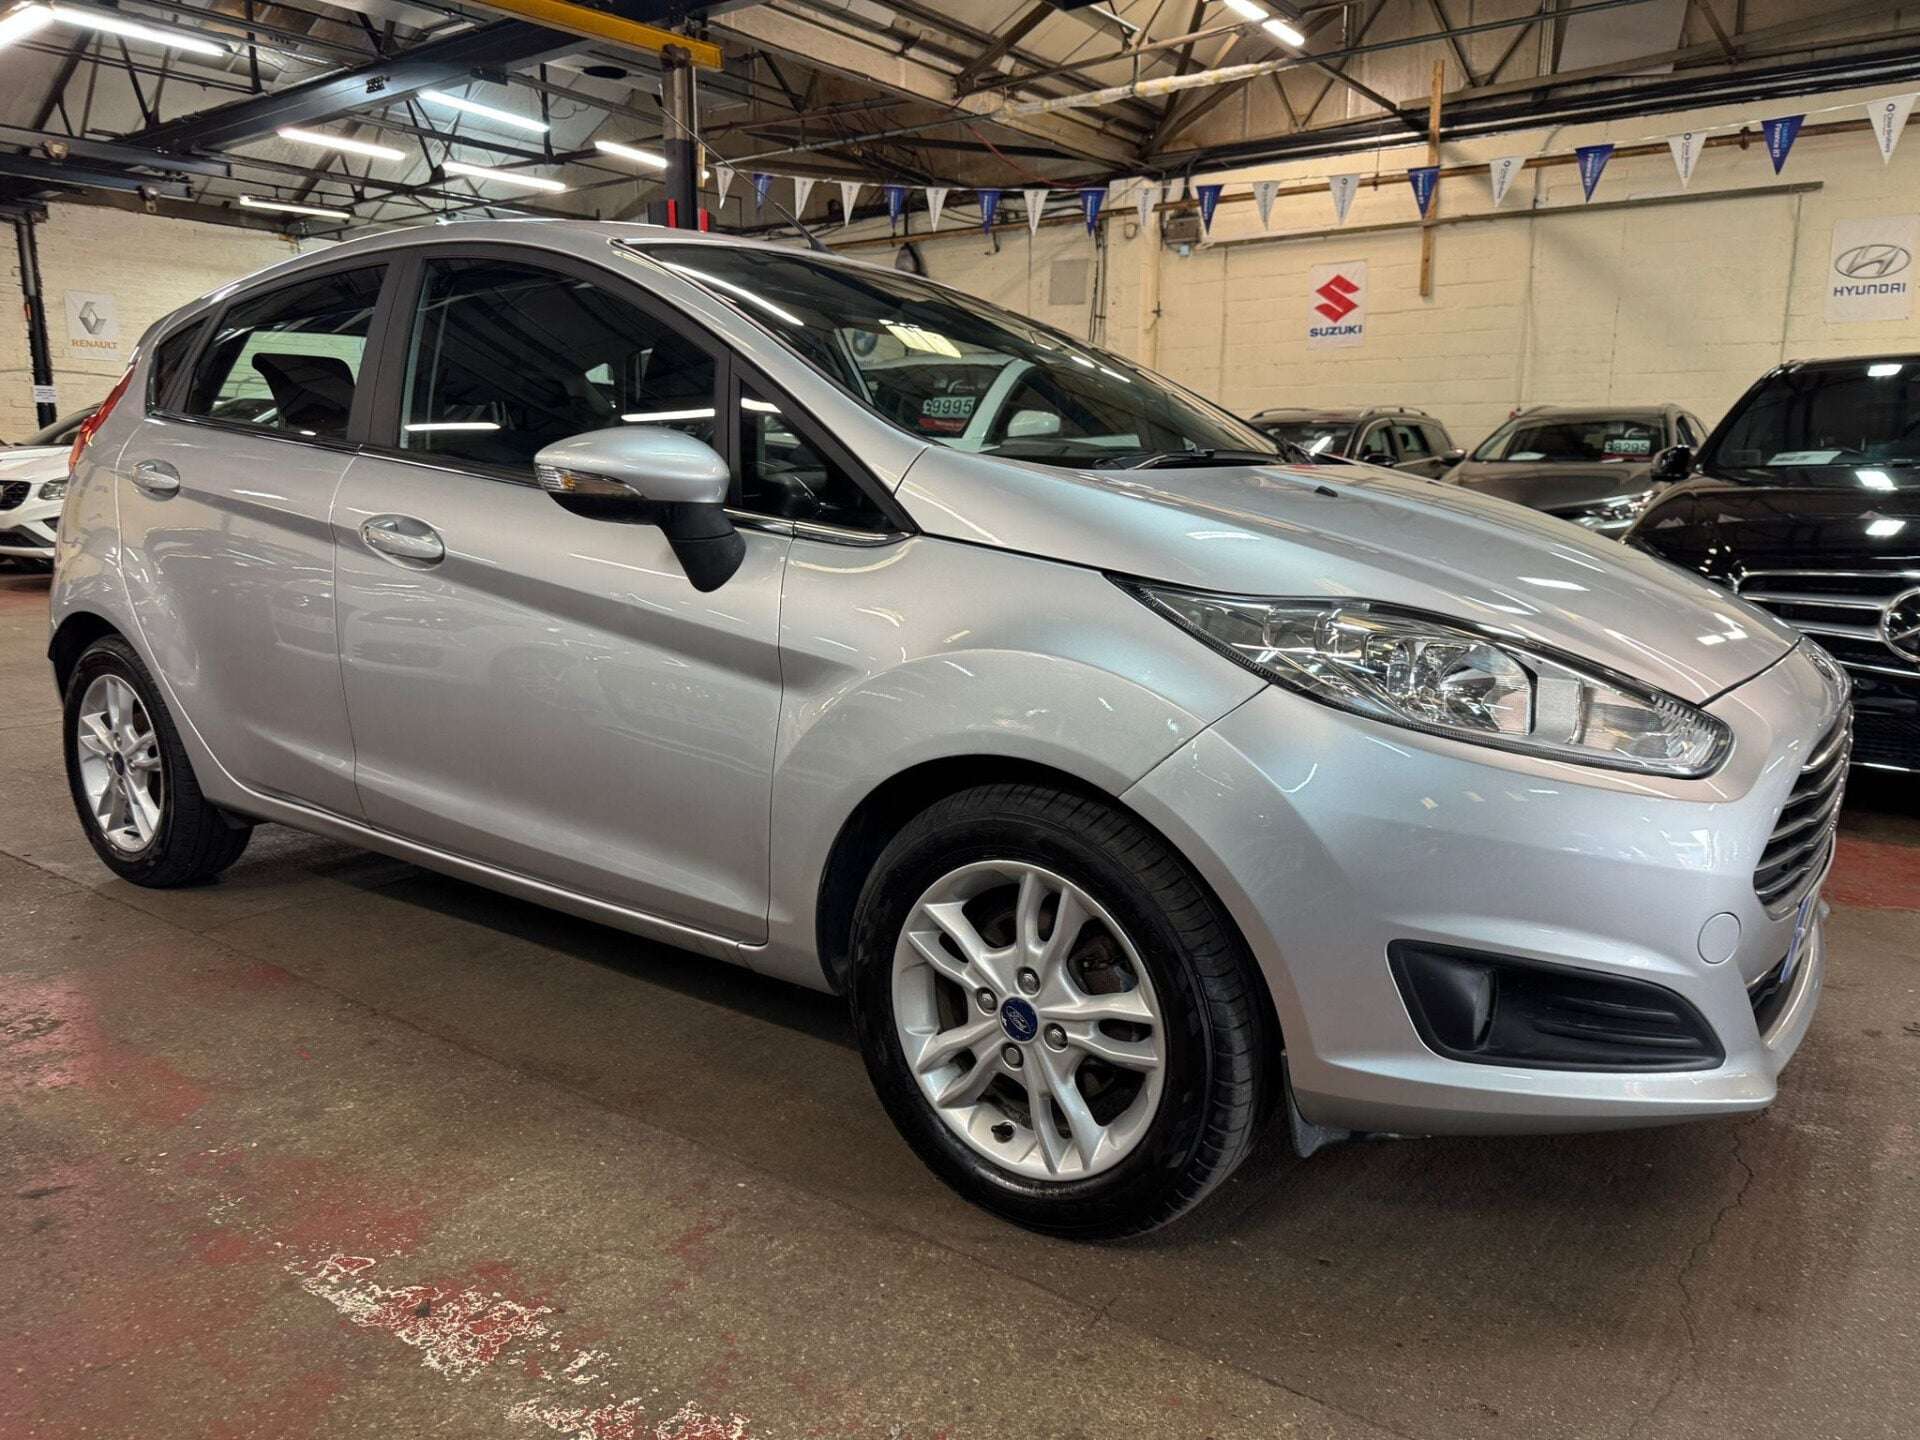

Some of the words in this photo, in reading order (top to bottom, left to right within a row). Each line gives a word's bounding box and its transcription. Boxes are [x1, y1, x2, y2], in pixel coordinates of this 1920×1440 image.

[1833, 283, 1906, 297] HYUNDAI
[1309, 325, 1363, 337] SUZUKI
[71, 339, 118, 349] RENAULT
[922, 399, 973, 415] £9995
